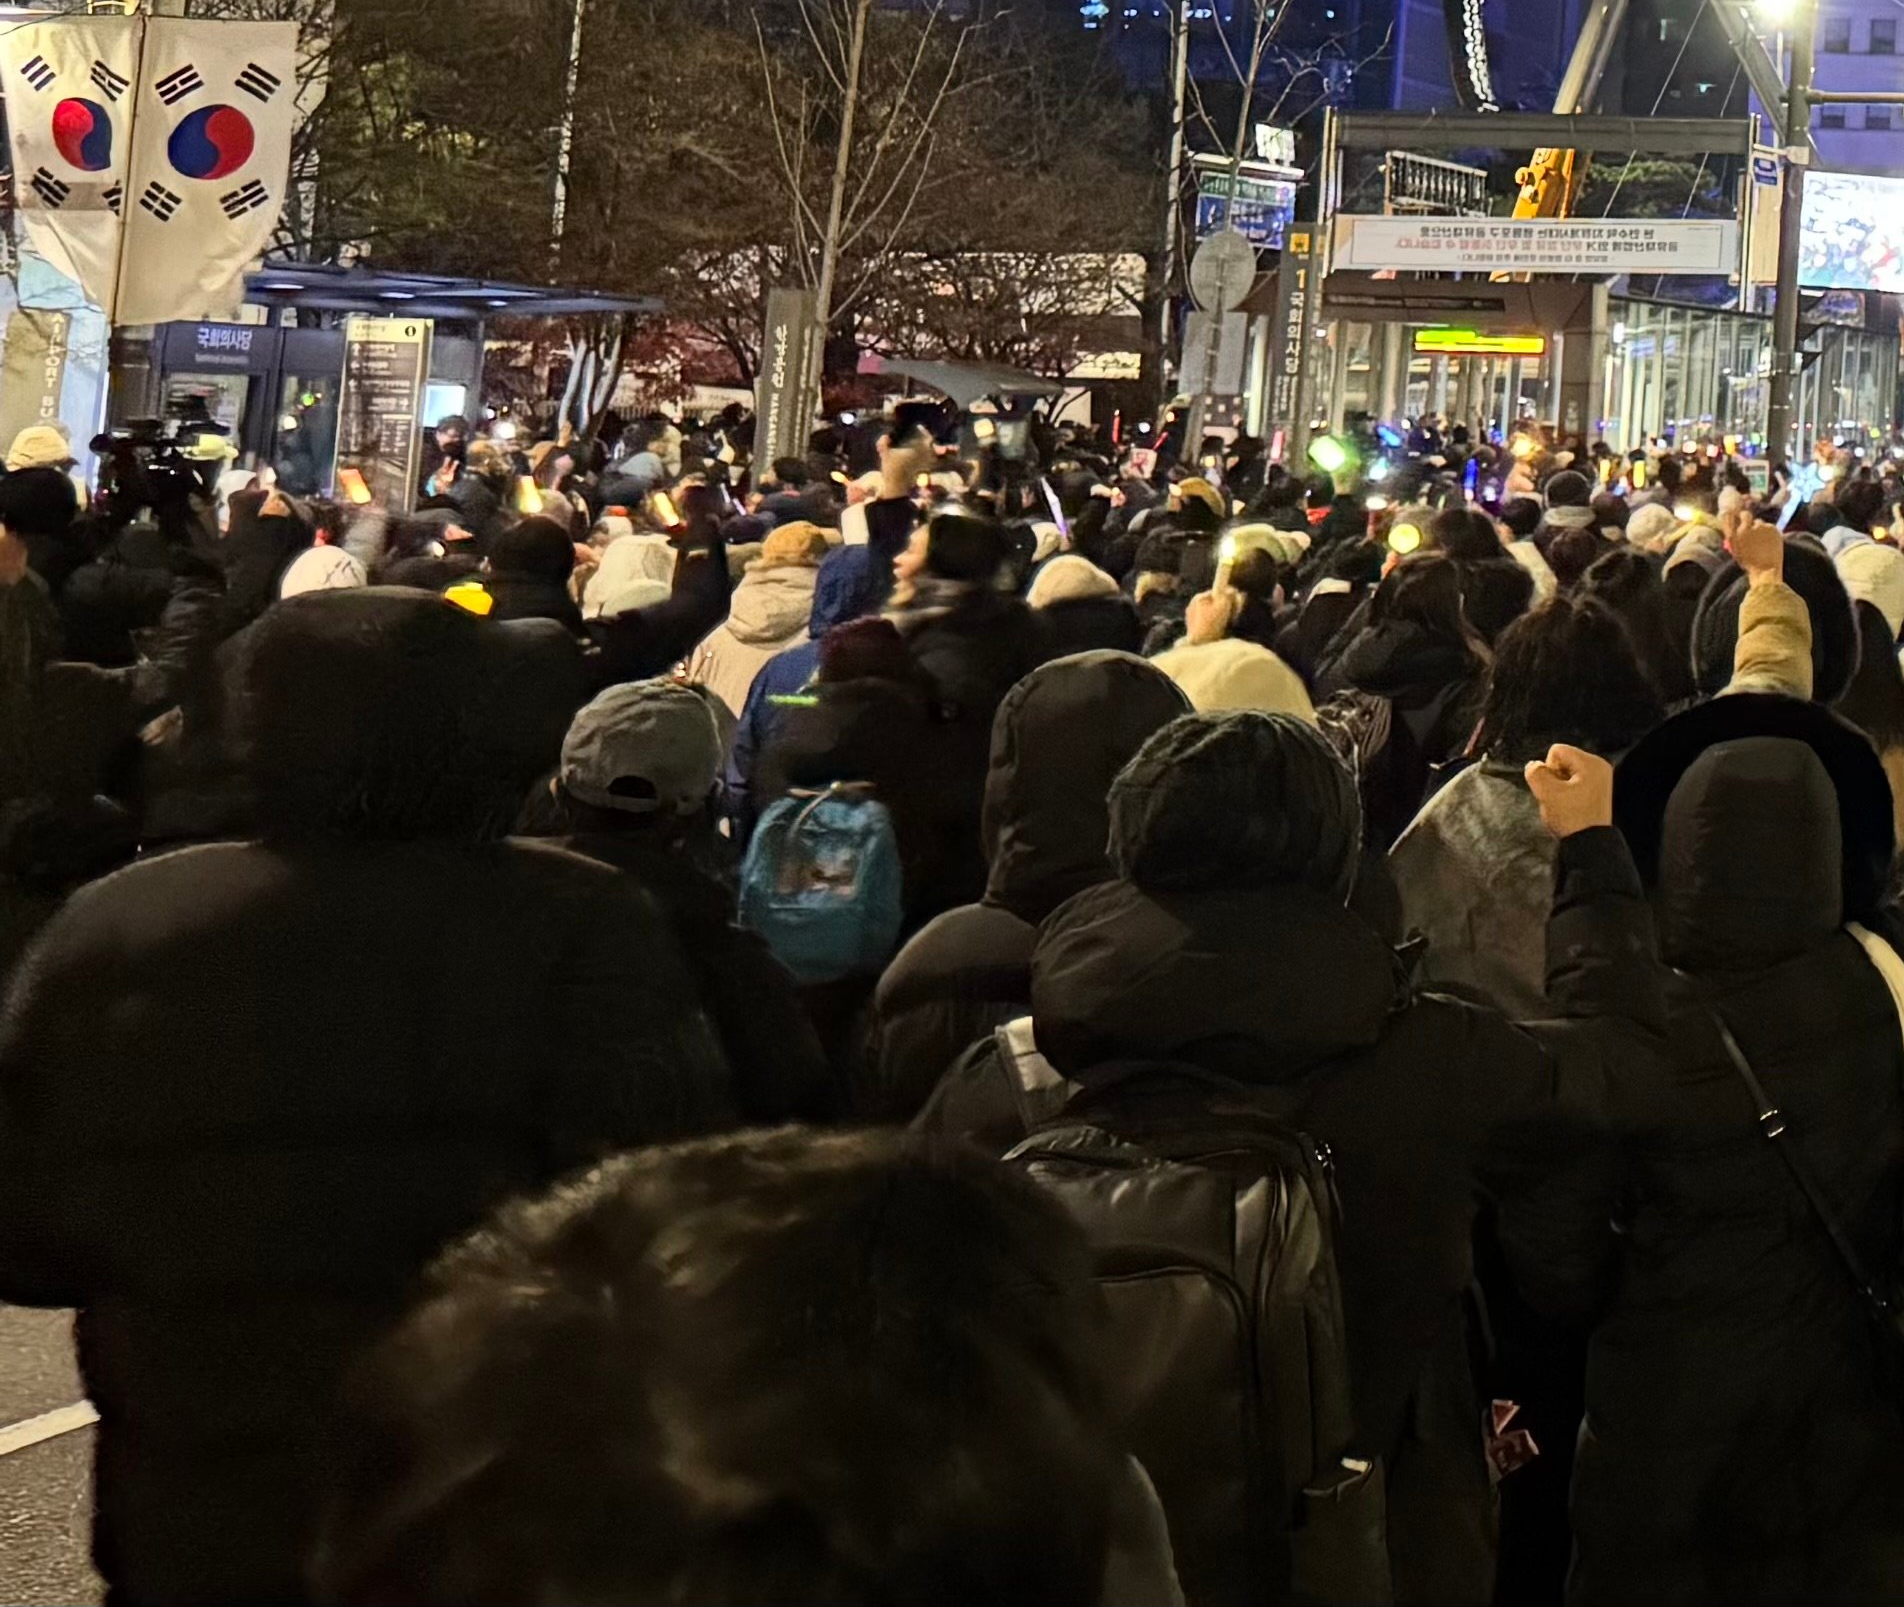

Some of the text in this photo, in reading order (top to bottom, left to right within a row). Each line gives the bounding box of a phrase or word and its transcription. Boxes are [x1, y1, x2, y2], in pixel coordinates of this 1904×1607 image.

[1296, 268, 1306, 289] 1
[198, 327, 252, 350] 국회의사당
[1285, 292, 1304, 374] 국회의사당
